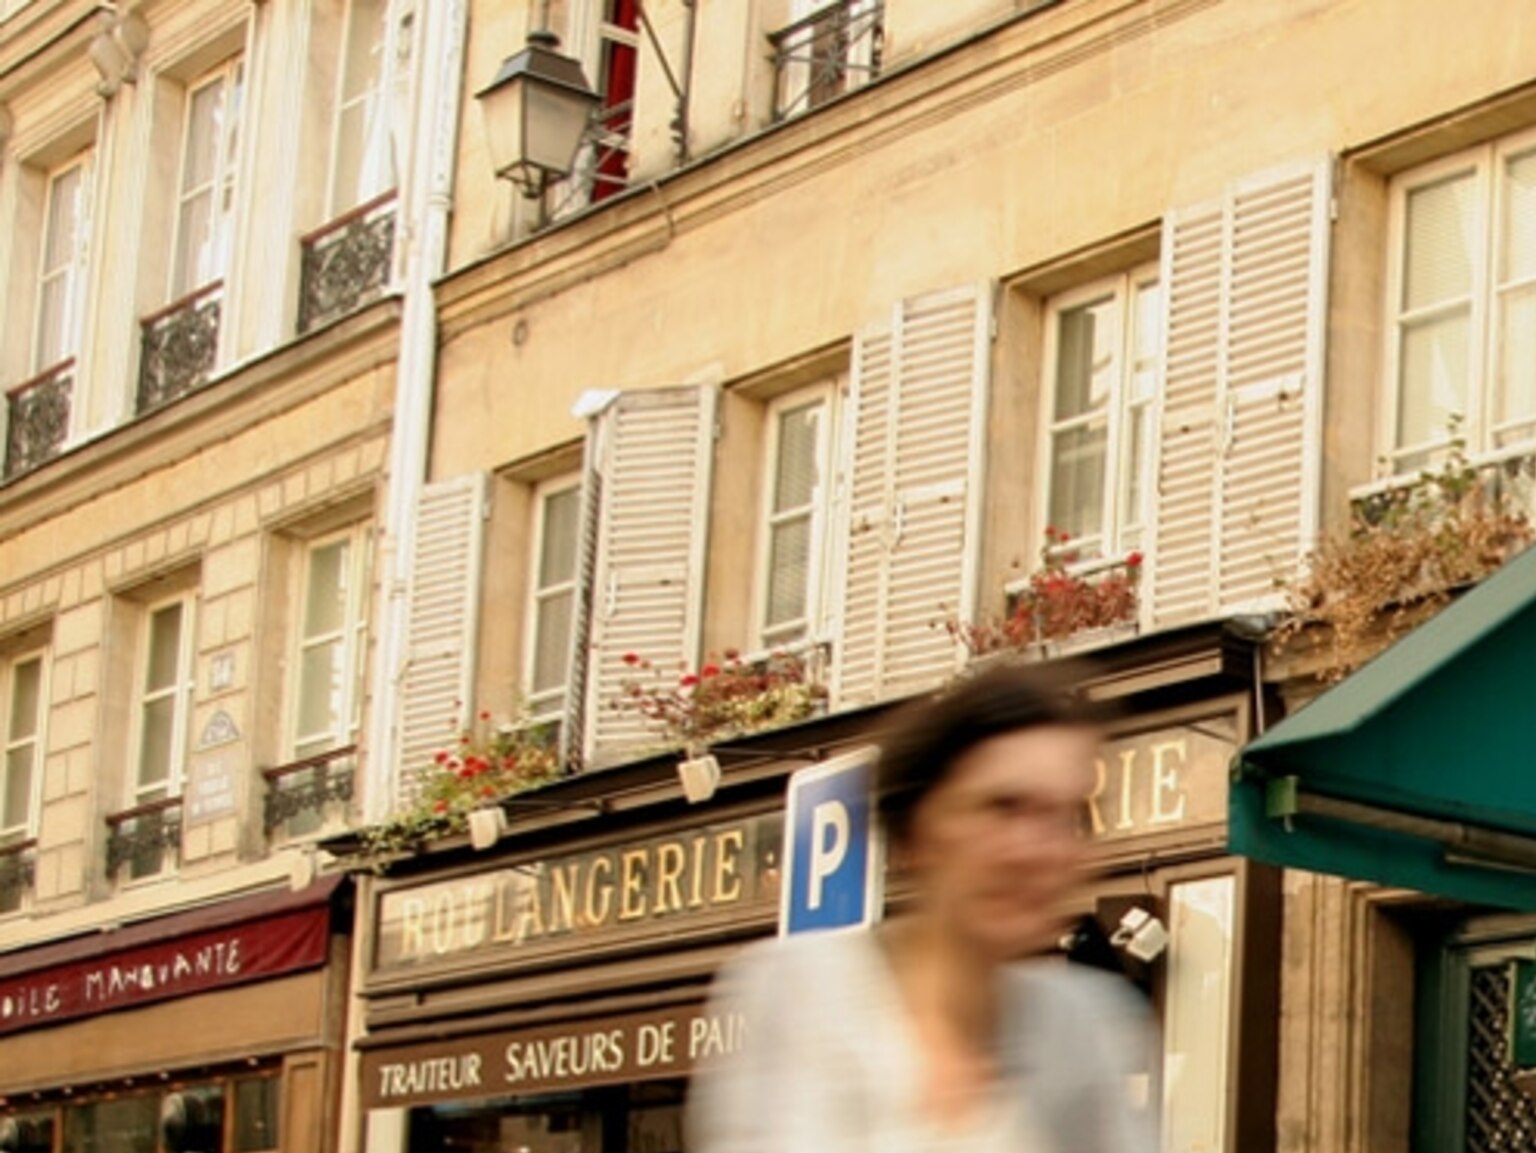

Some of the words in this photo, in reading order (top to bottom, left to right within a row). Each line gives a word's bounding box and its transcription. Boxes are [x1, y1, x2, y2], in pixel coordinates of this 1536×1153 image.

[808, 799, 851, 911] P
[379, 1052, 482, 1098] TRAITEUR
[505, 1029, 624, 1083] SAVEURS
[637, 1021, 675, 1067] DE
